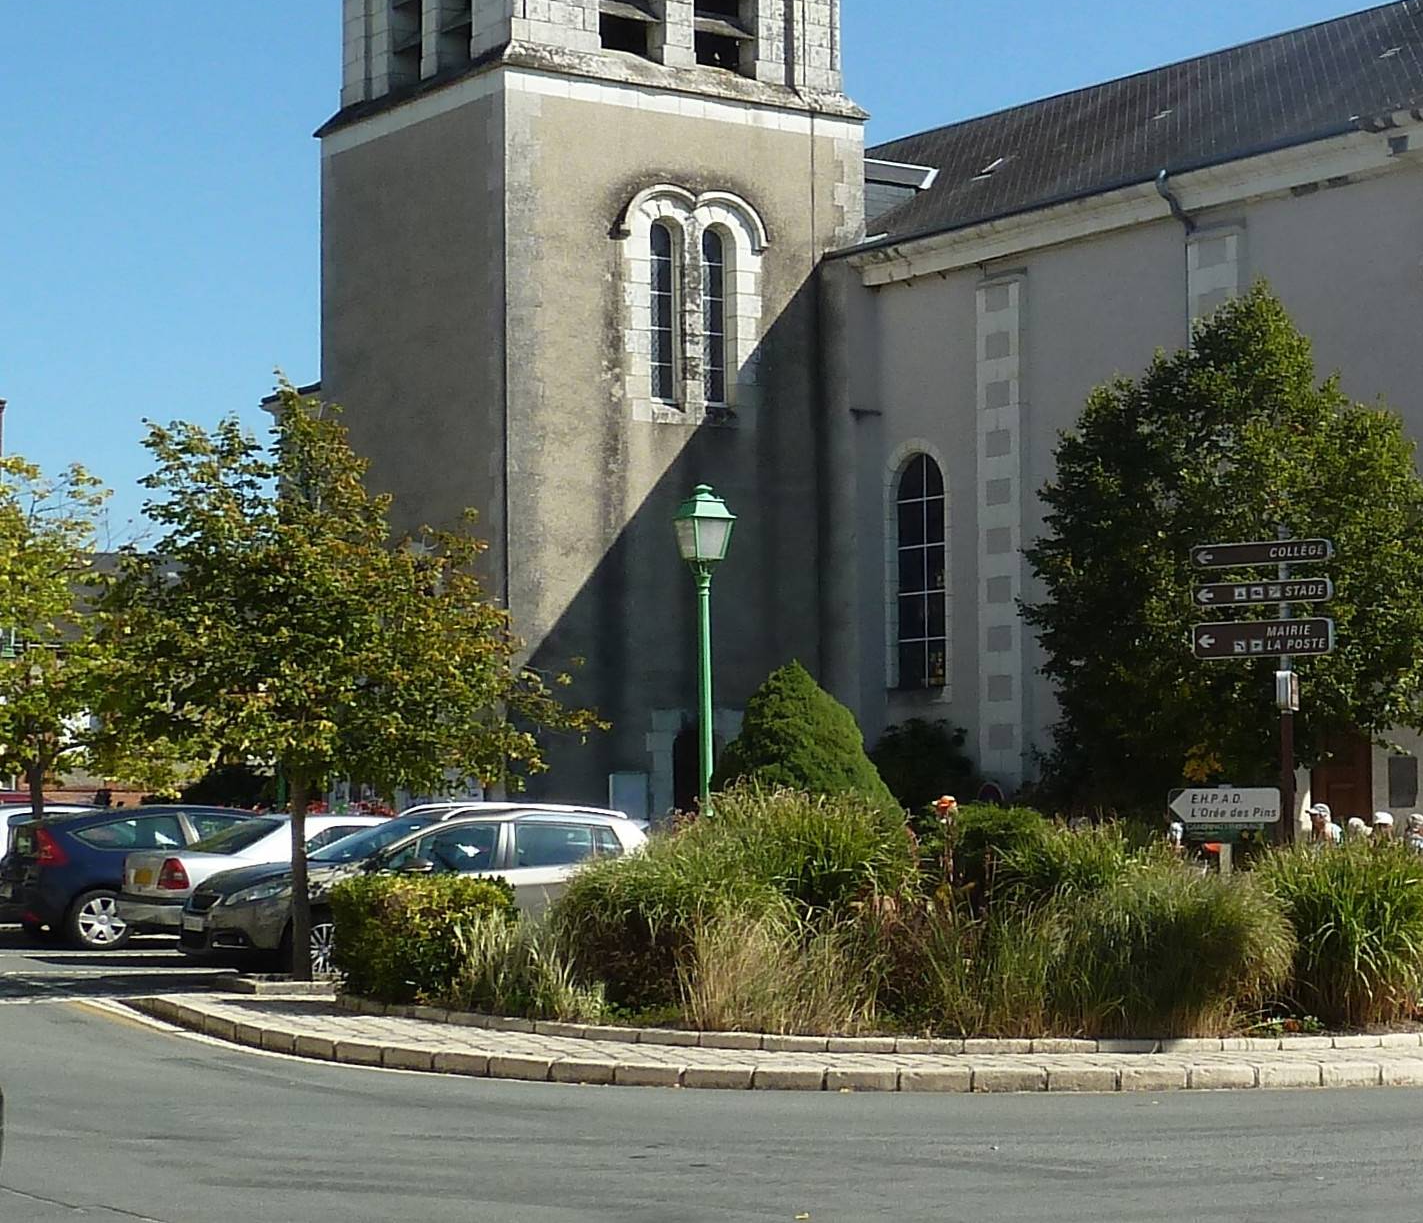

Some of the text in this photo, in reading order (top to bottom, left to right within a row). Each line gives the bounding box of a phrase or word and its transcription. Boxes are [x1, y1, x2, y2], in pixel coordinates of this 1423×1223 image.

[1285, 584, 1325, 597] STADE
[1266, 624, 1311, 636] MAIRIE
[1266, 637, 1326, 651] LA POSTE
[1191, 807, 1277, 818] L'Orée des Pins
